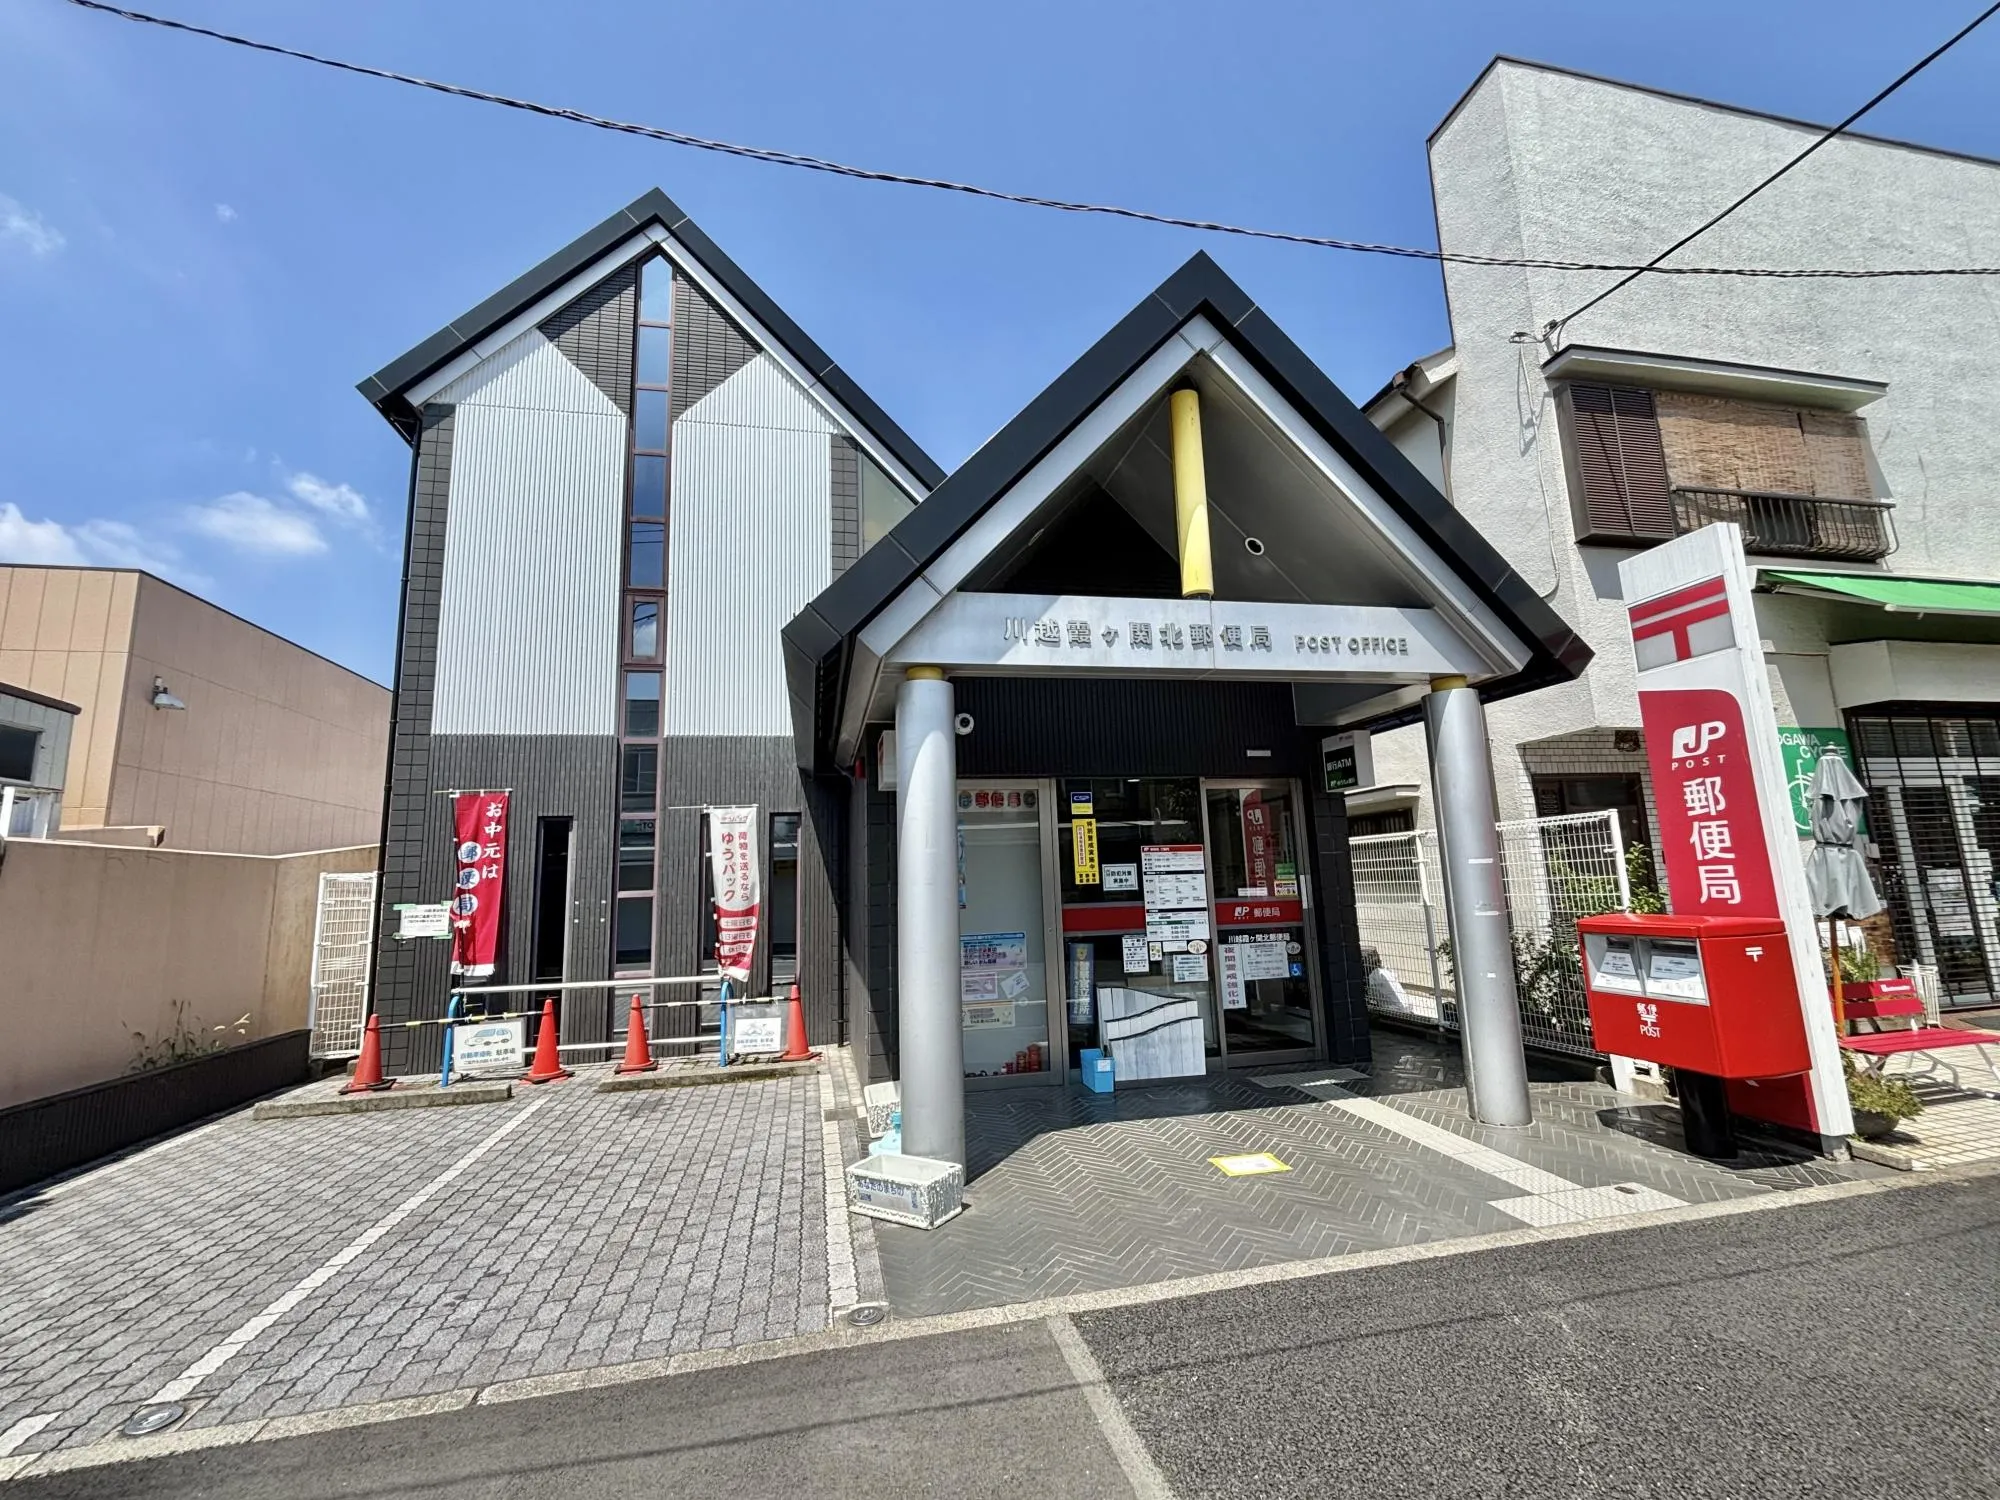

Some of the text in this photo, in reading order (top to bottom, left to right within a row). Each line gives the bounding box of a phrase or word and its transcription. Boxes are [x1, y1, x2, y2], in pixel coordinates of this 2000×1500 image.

[1003, 617, 1272, 650] 川越霞ヶ関北郵便局
[1294, 635, 1409, 656] POST OFFICE
[1672, 720, 1727, 759] JP
[1671, 754, 1726, 771] POST
[481, 801, 503, 880] お中元は
[1682, 776, 1742, 905] 郵便局
[721, 831, 737, 902] ゆうパック
[1253, 906, 1281, 918] 郵便局
[1636, 1002, 1658, 1016] 郵便
[1639, 1025, 1661, 1038] POST
